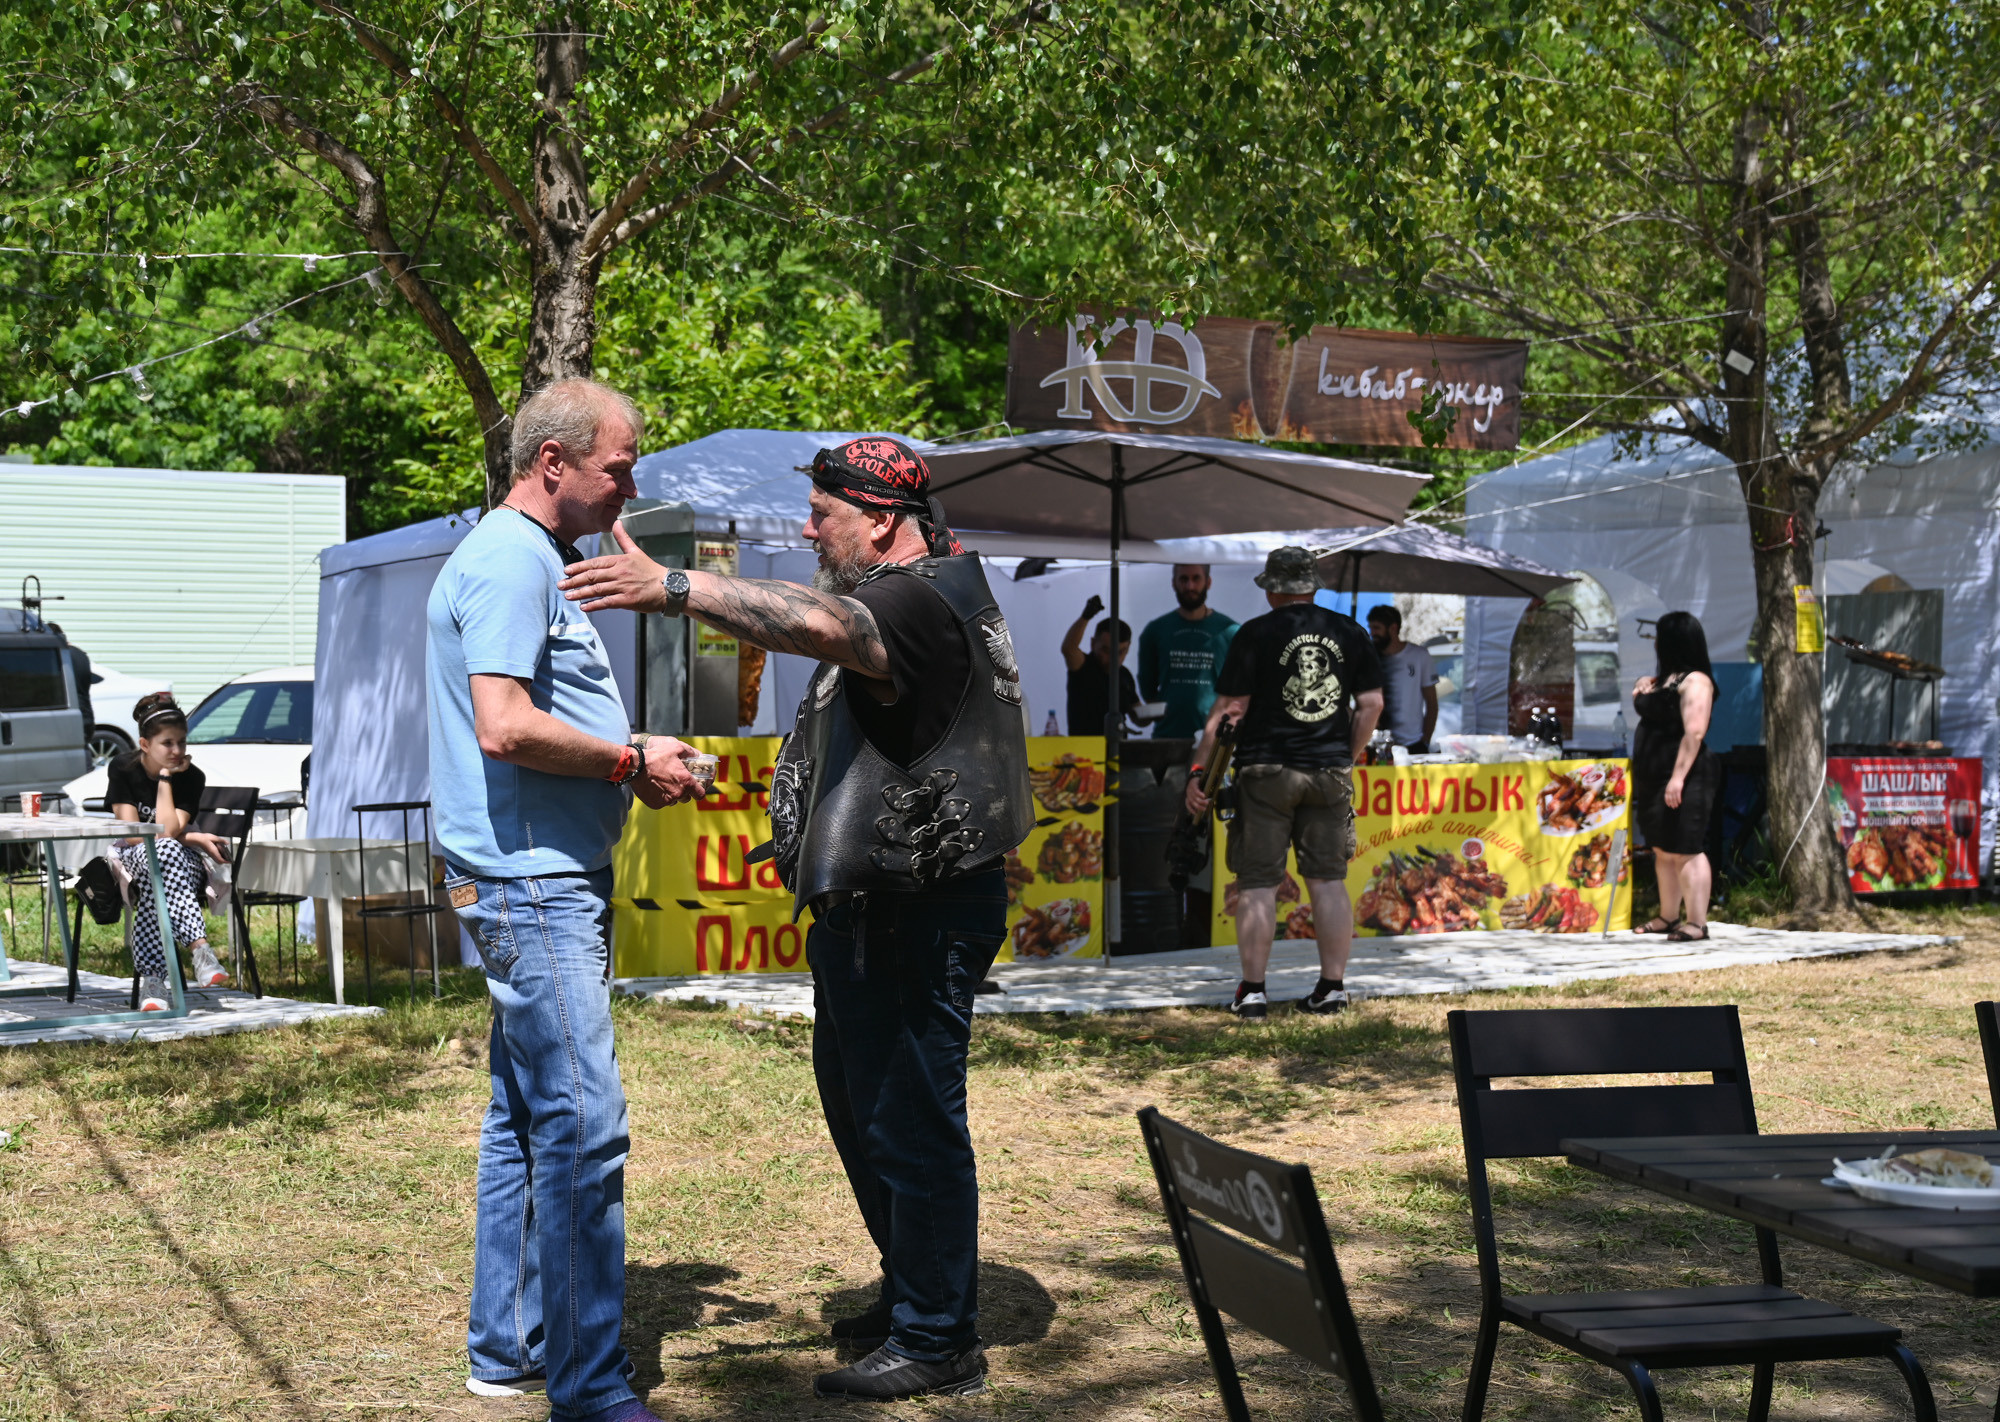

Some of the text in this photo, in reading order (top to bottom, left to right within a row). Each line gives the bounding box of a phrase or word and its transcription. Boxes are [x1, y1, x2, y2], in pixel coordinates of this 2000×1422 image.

[1279, 634, 1345, 666] MOTORCYCLE ADDICT
[1861, 773, 1947, 792] ШАШЛЫК
[1442, 820, 1550, 868] аппетита!
